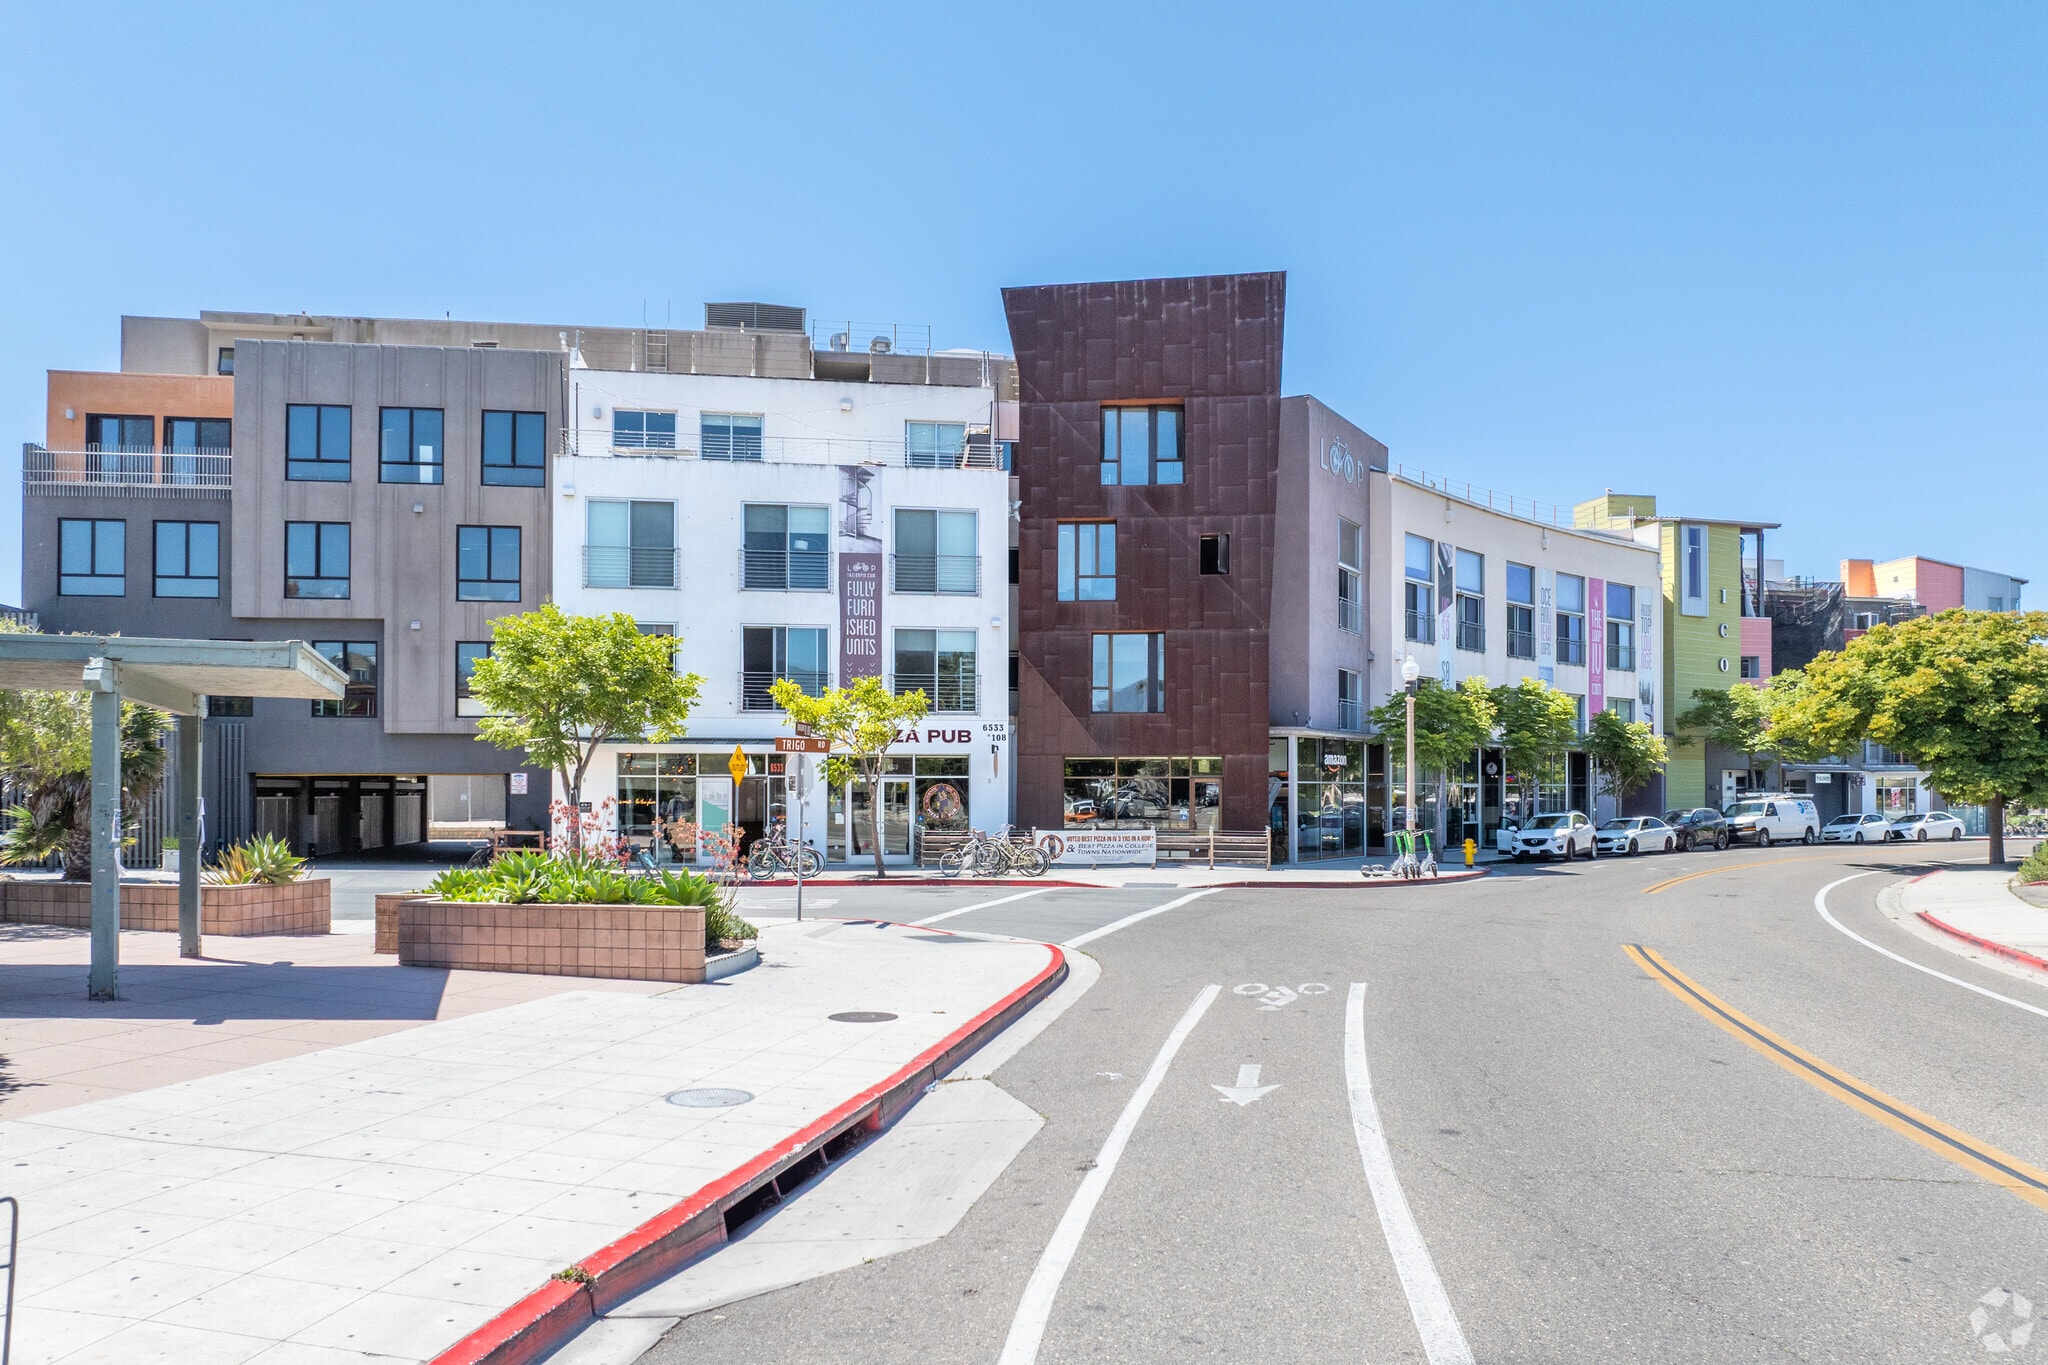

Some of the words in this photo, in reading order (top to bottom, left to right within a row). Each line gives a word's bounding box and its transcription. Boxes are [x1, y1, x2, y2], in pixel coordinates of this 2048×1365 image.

[847, 581, 875, 597] FULLY
[847, 599, 875, 616] FURN
[846, 618, 876, 635] ISHED
[1591, 609, 1601, 628] THE
[1641, 617, 1652, 634] TOP
[846, 638, 876, 655] UNITS
[1441, 660, 1450, 682] SB
[782, 739, 805, 750] TRIGO
[927, 729, 972, 743] PUB
[1324, 754, 1347, 765] amazon
[1066, 844, 1075, 853] &
